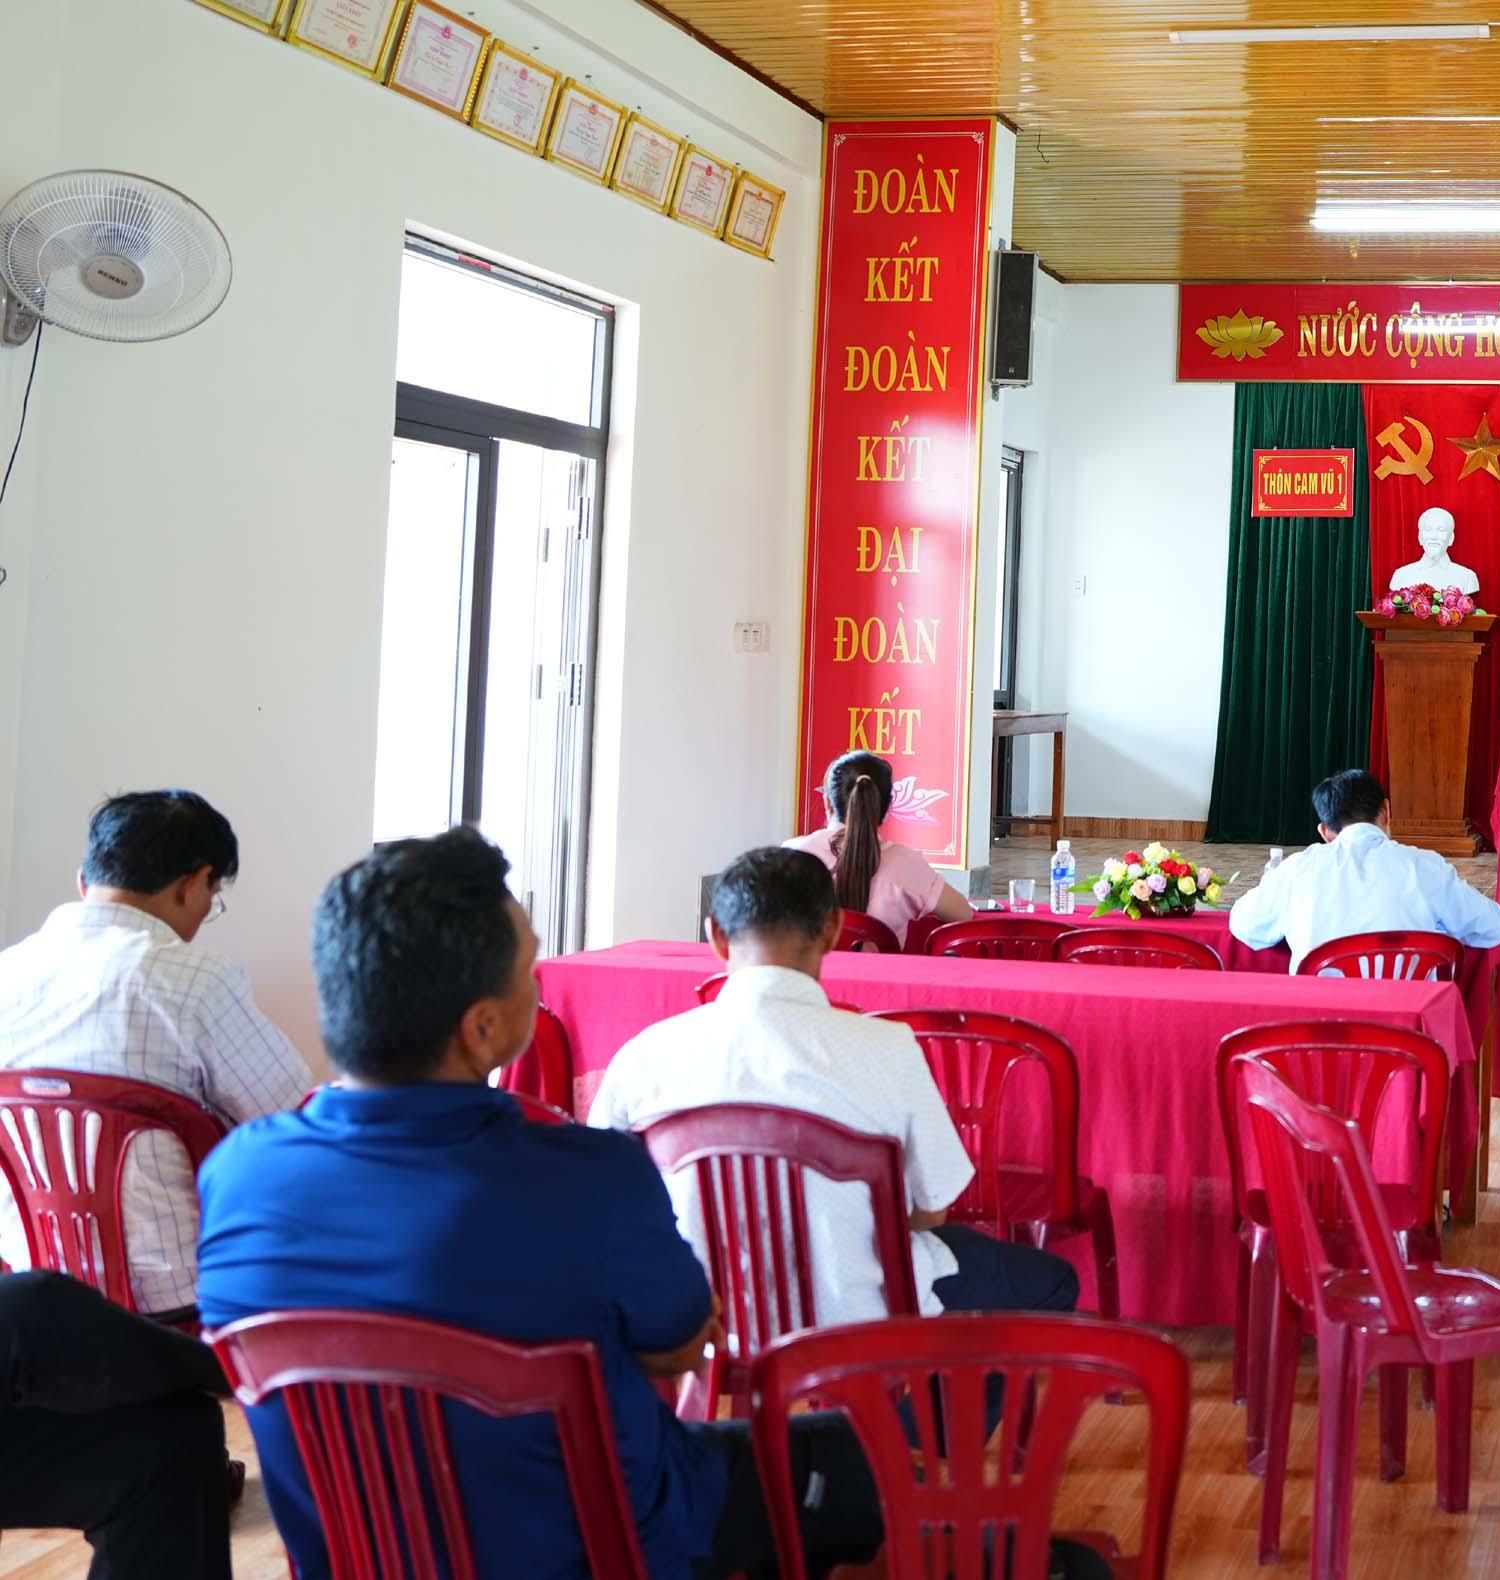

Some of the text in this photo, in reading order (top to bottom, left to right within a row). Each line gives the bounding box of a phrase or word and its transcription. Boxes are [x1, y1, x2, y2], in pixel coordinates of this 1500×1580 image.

[853, 154, 959, 214] ĐOÀN
[864, 236, 939, 302] KẾT
[844, 330, 951, 392] ĐOÀN
[1297, 301, 1378, 358] NƯỚC
[1385, 301, 1464, 369] CỘNG
[856, 414, 931, 482] KẾT
[1263, 467, 1343, 495] THÔN CAM VŨ 1
[856, 522, 923, 588] ĐẠI
[833, 601, 941, 664] ĐOÀN
[847, 687, 922, 756] KẾT
